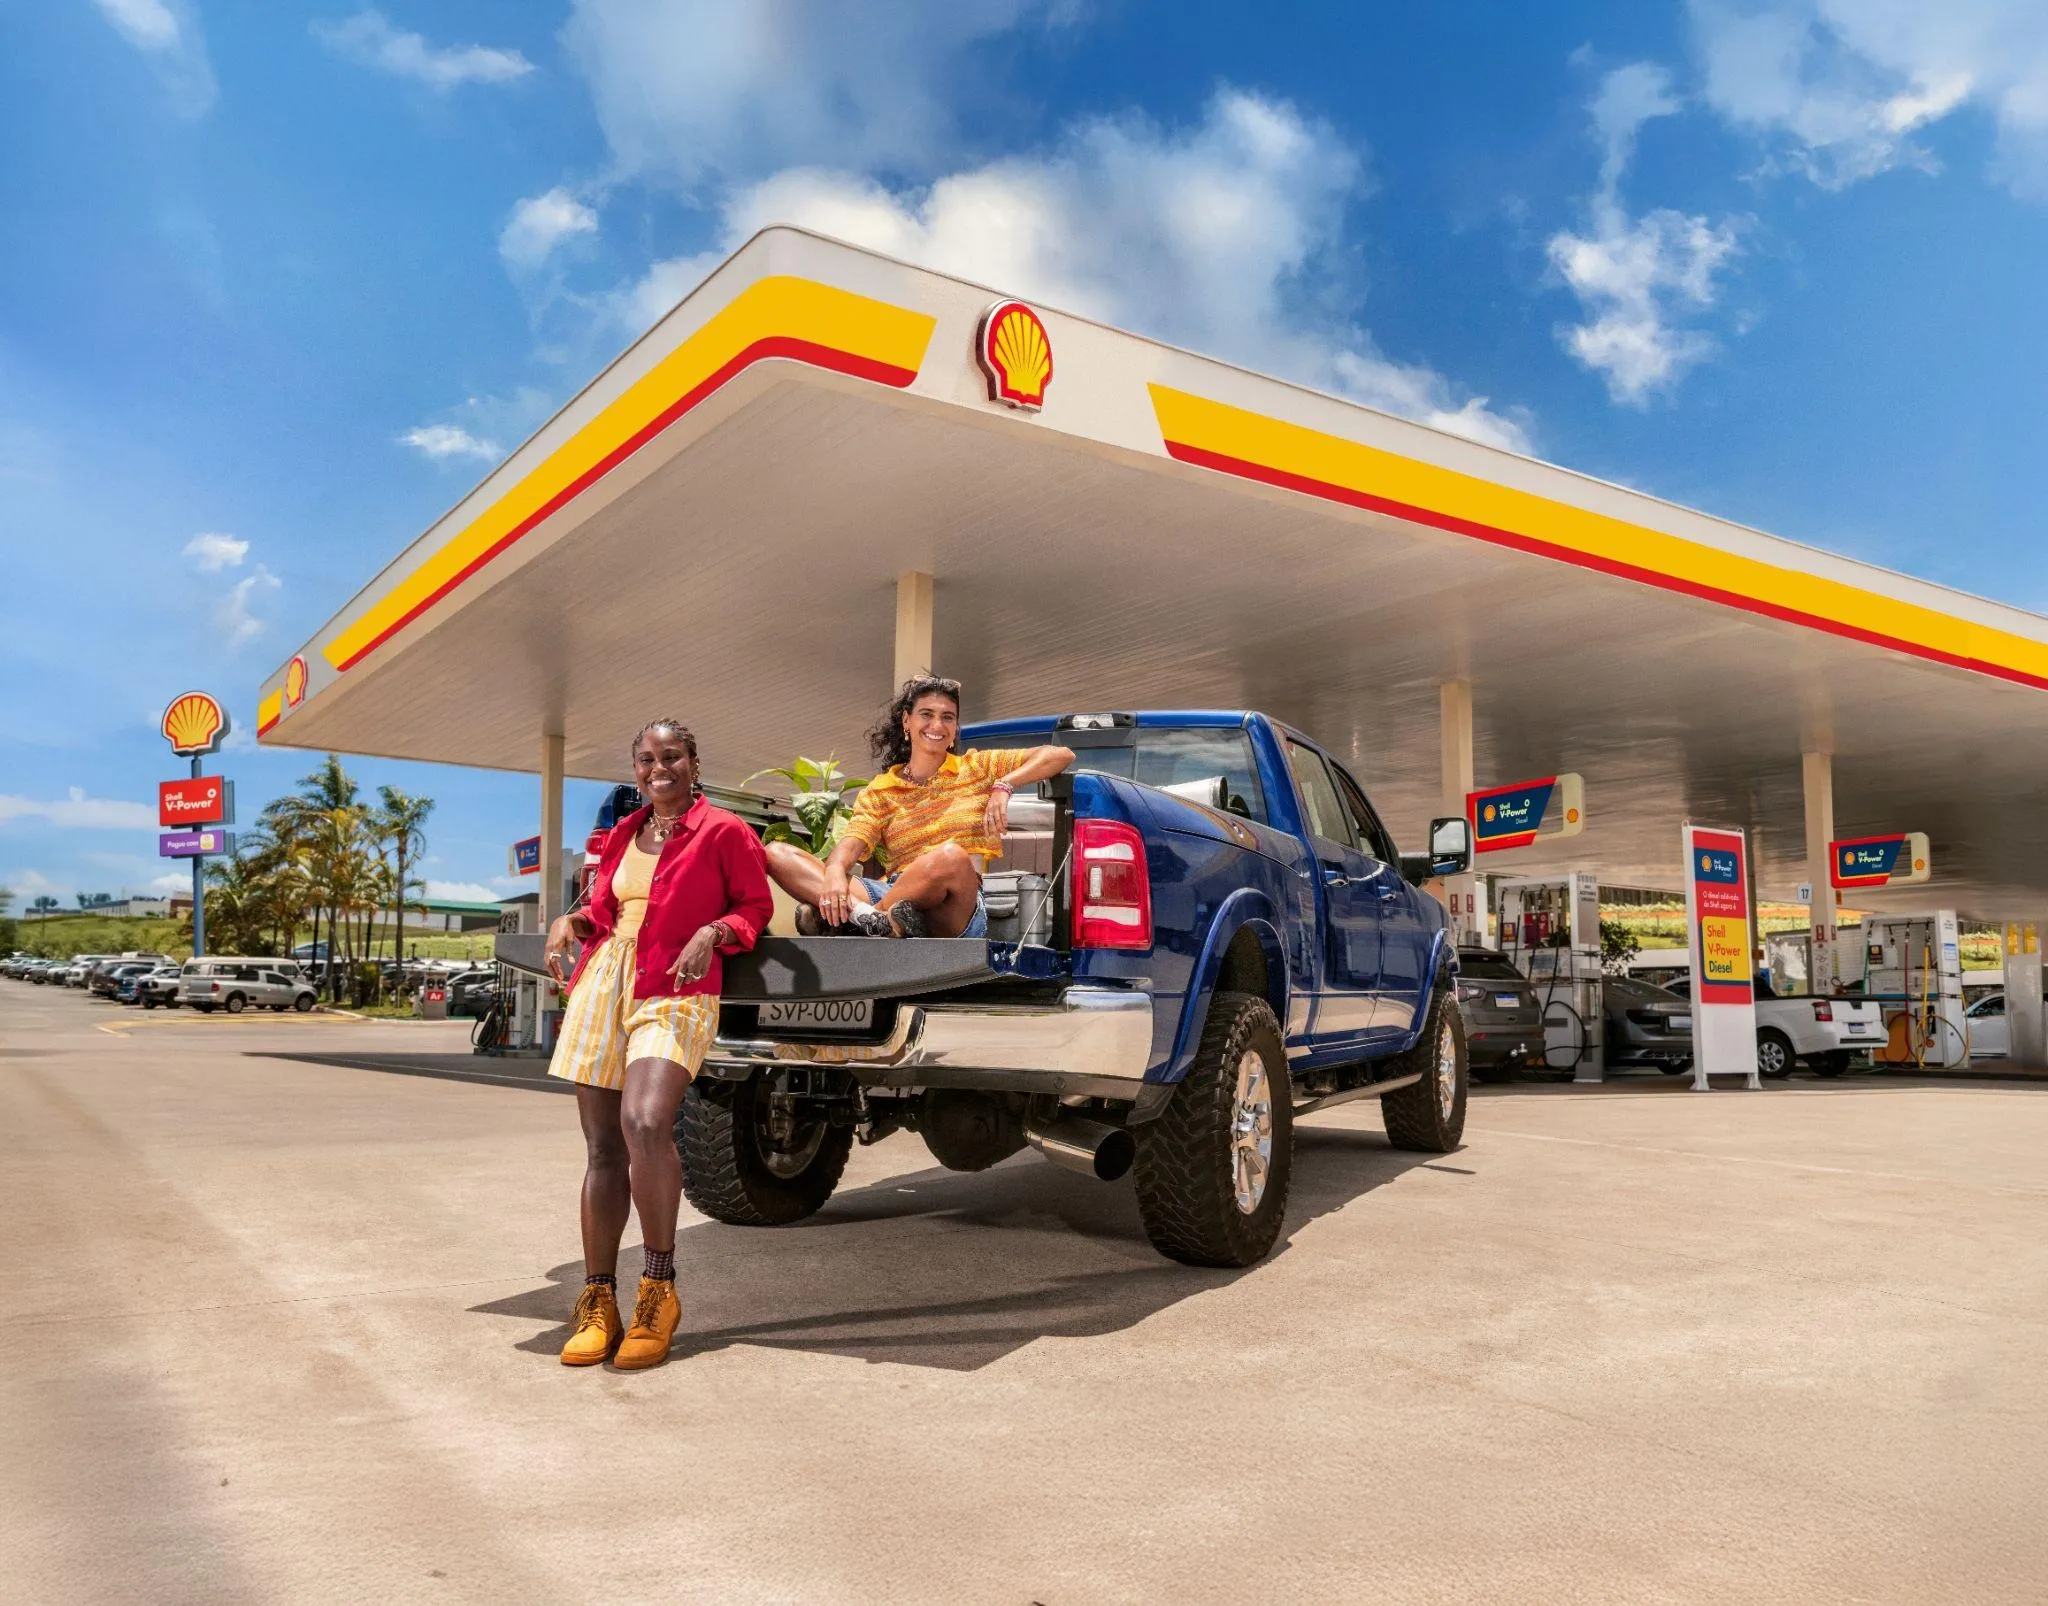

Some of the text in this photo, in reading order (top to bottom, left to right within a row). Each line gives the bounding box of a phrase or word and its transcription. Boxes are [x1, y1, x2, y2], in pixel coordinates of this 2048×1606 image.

[165, 792, 183, 801] Shell
[165, 800, 213, 811] V-Power
[1500, 808, 1528, 818] V-Power
[1800, 888, 1809, 900] 17
[1707, 924, 1726, 938] Shell
[1707, 942, 1741, 957] V-Power
[1709, 960, 1732, 973] Diesel
[430, 992, 442, 1000] Ar
[770, 1001, 866, 1021] SVP-0000
